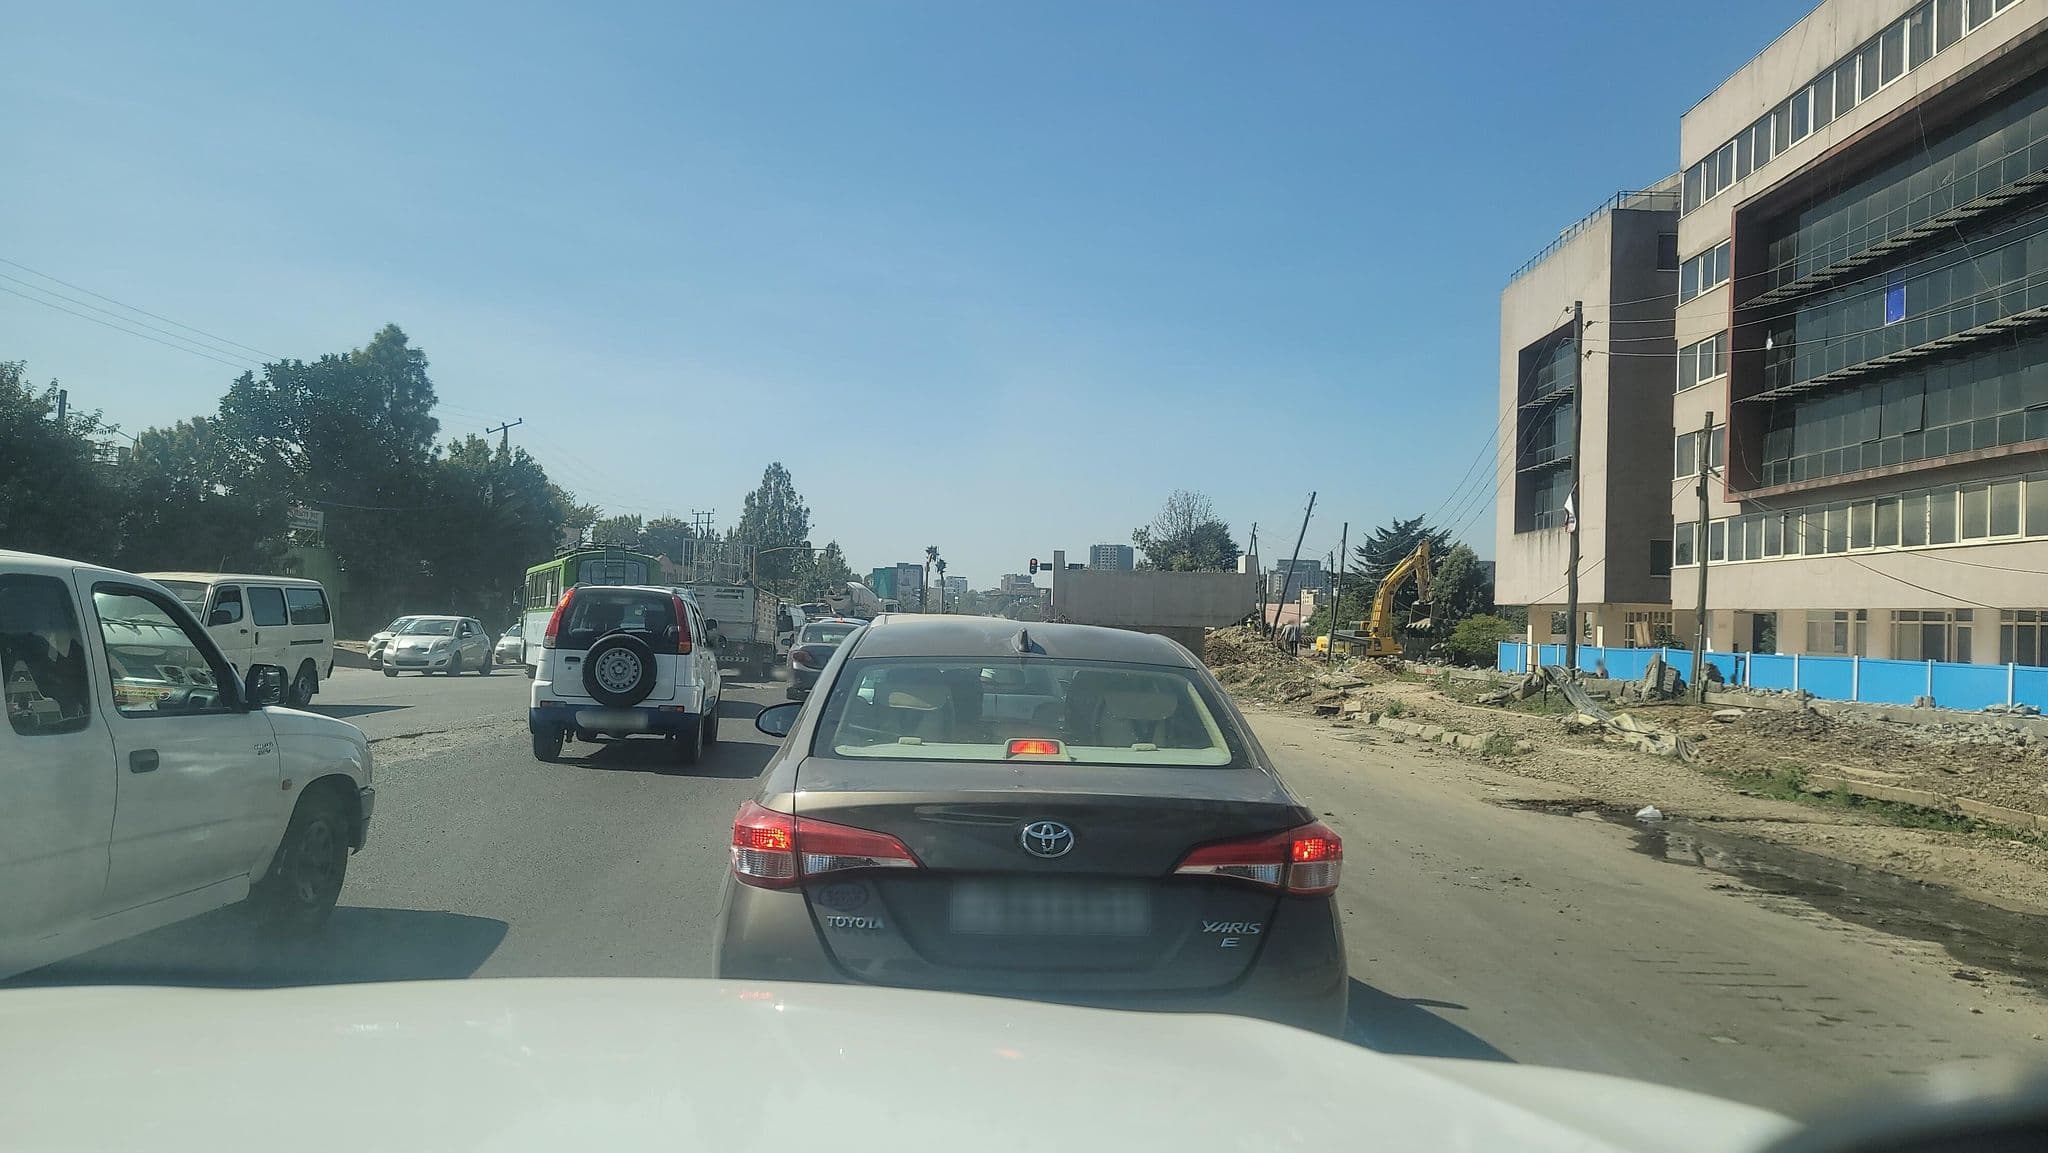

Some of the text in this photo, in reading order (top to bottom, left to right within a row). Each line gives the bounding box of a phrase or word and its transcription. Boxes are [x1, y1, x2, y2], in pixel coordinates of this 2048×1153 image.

[826, 915, 884, 929] TOYOTA
[1202, 920, 1262, 934] YARIS
[1220, 937, 1241, 948] E
